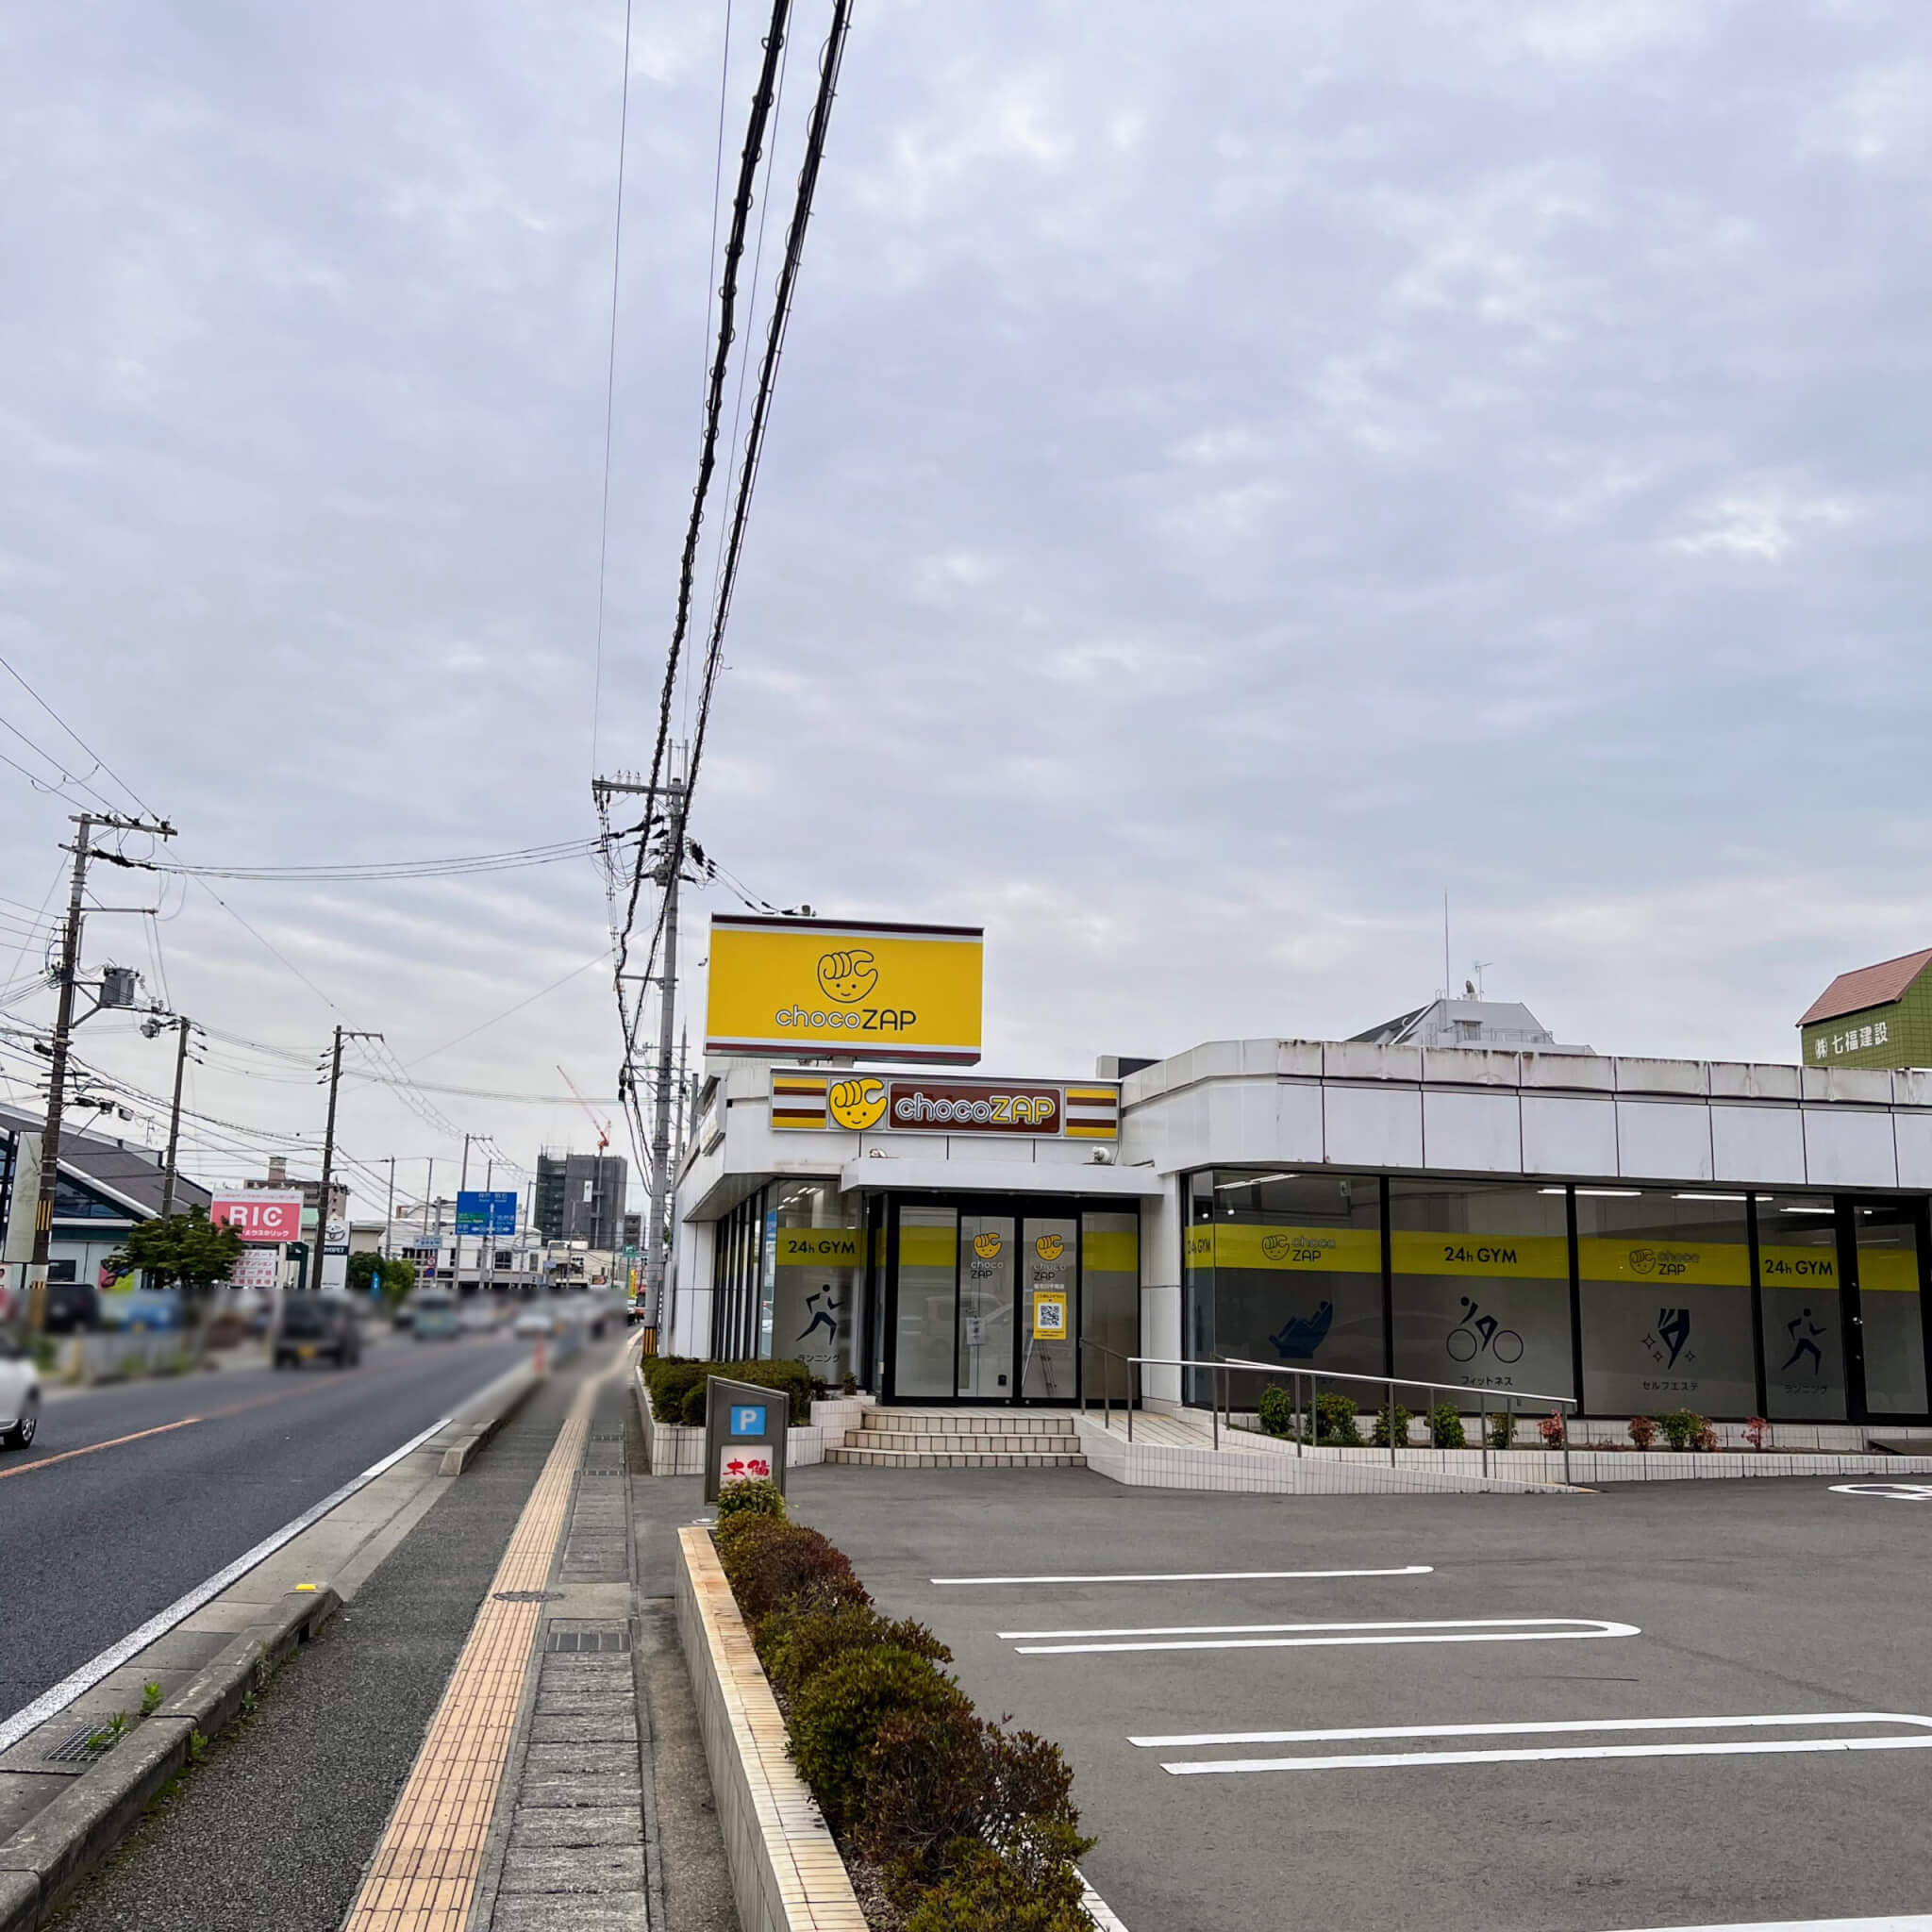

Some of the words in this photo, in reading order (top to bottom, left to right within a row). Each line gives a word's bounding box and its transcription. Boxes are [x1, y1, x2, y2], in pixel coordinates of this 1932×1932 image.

[775, 1005, 917, 1031] chocoZAP
[895, 1092, 1056, 1124] chocoZAP
[229, 1206, 282, 1226] RIC
[788, 1240, 815, 1254] 24h
[818, 1241, 855, 1254] GYM
[1292, 1249, 1322, 1262] ZAP
[1444, 1246, 1474, 1261] 24h
[1476, 1247, 1518, 1263] GYM
[971, 1259, 1004, 1269] choco
[1658, 1263, 1687, 1275] ZAP
[1765, 1259, 1791, 1274] 24h
[1795, 1260, 1833, 1275] GYM
[971, 1270, 992, 1279] ZAP
[1033, 1272, 1056, 1281] ZAP
[1460, 1375, 1513, 1386] フィットネス
[1642, 1381, 1699, 1391] セルフエステ
[741, 1409, 757, 1431] P
